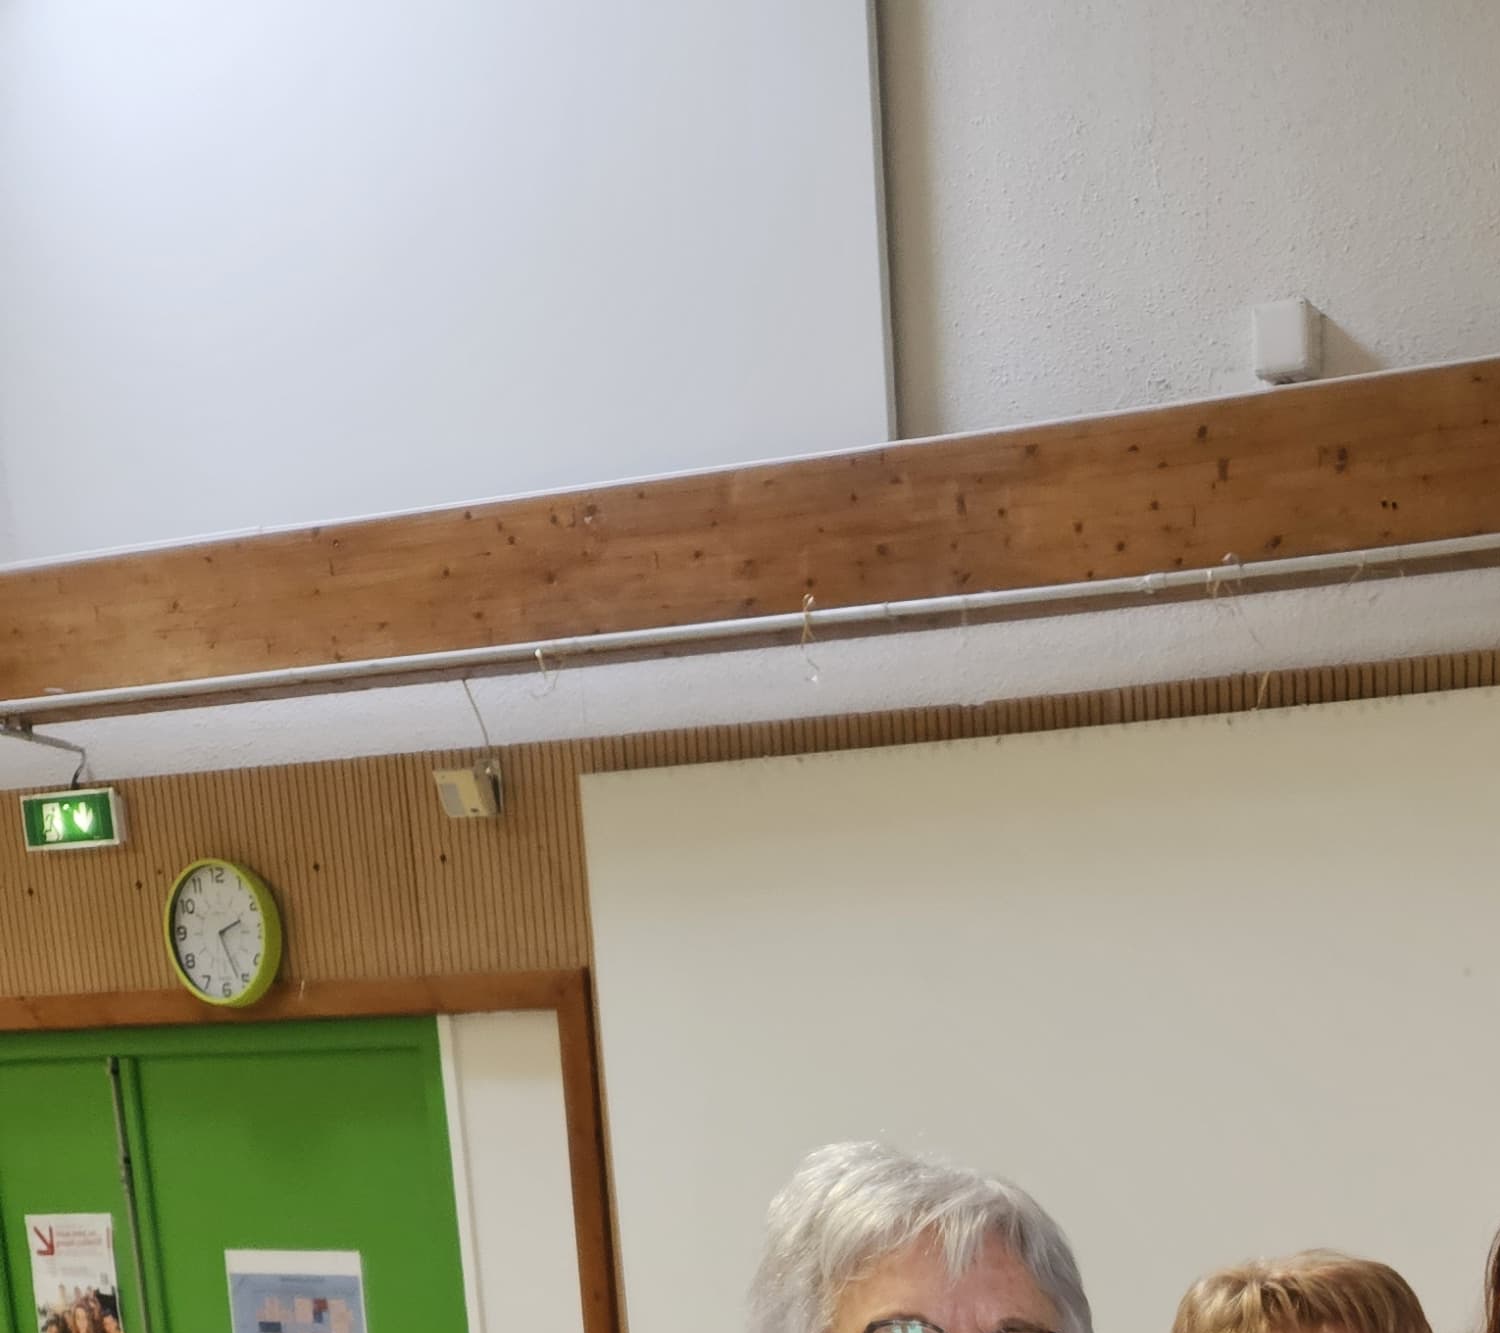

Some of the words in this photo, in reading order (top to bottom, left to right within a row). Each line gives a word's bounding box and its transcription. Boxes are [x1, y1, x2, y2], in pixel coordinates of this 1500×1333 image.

[209, 868, 224, 883] 12
[192, 878, 202, 894] 11
[180, 899, 195, 914] 10
[176, 926, 187, 941] 9
[185, 953, 195, 969] 8
[202, 975, 211, 990] 7
[222, 982, 232, 997] 6
